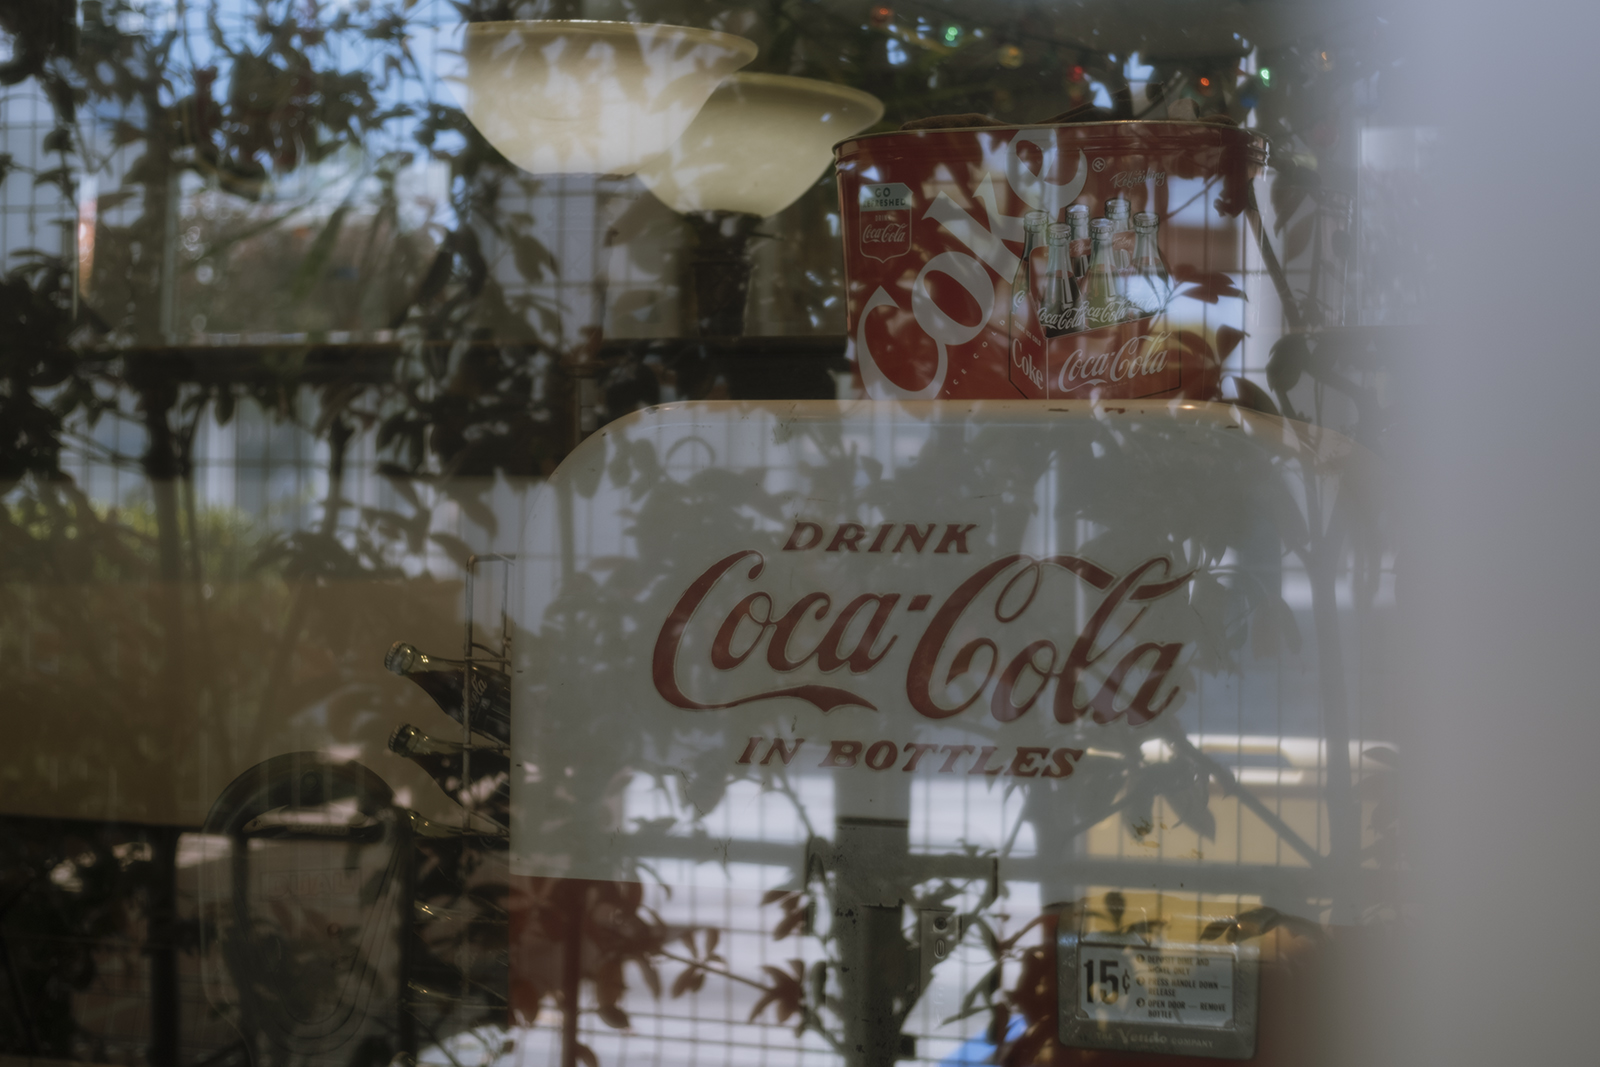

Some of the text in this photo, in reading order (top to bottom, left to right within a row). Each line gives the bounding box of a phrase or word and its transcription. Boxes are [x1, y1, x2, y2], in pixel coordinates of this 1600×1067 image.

[875, 187, 891, 198] GO
[863, 222, 909, 244] Coca-Cola
[857, 128, 1088, 400] Coke
[1012, 338, 1044, 390] Coke
[1058, 330, 1172, 393] Coca-Cola
[782, 520, 979, 554] DRINK
[652, 549, 1200, 727] Coca-Cola
[736, 736, 1085, 779] IN BOTTLES
[1196, 957, 1210, 967] AND
[1148, 976, 1169, 987] PRESS
[1171, 978, 1197, 989] HANDLE
[1199, 979, 1219, 990] DOWN
[1148, 987, 1176, 998] RELEASE
[1147, 999, 1166, 1009] OPEN
[1167, 1000, 1186, 1011] DOOR
[1199, 1001, 1226, 1013] REMOVE
[1147, 1009, 1172, 1019] BOTTLE
[1115, 1027, 1168, 1045] Vendo
[1171, 1035, 1215, 1049] COMPANY
